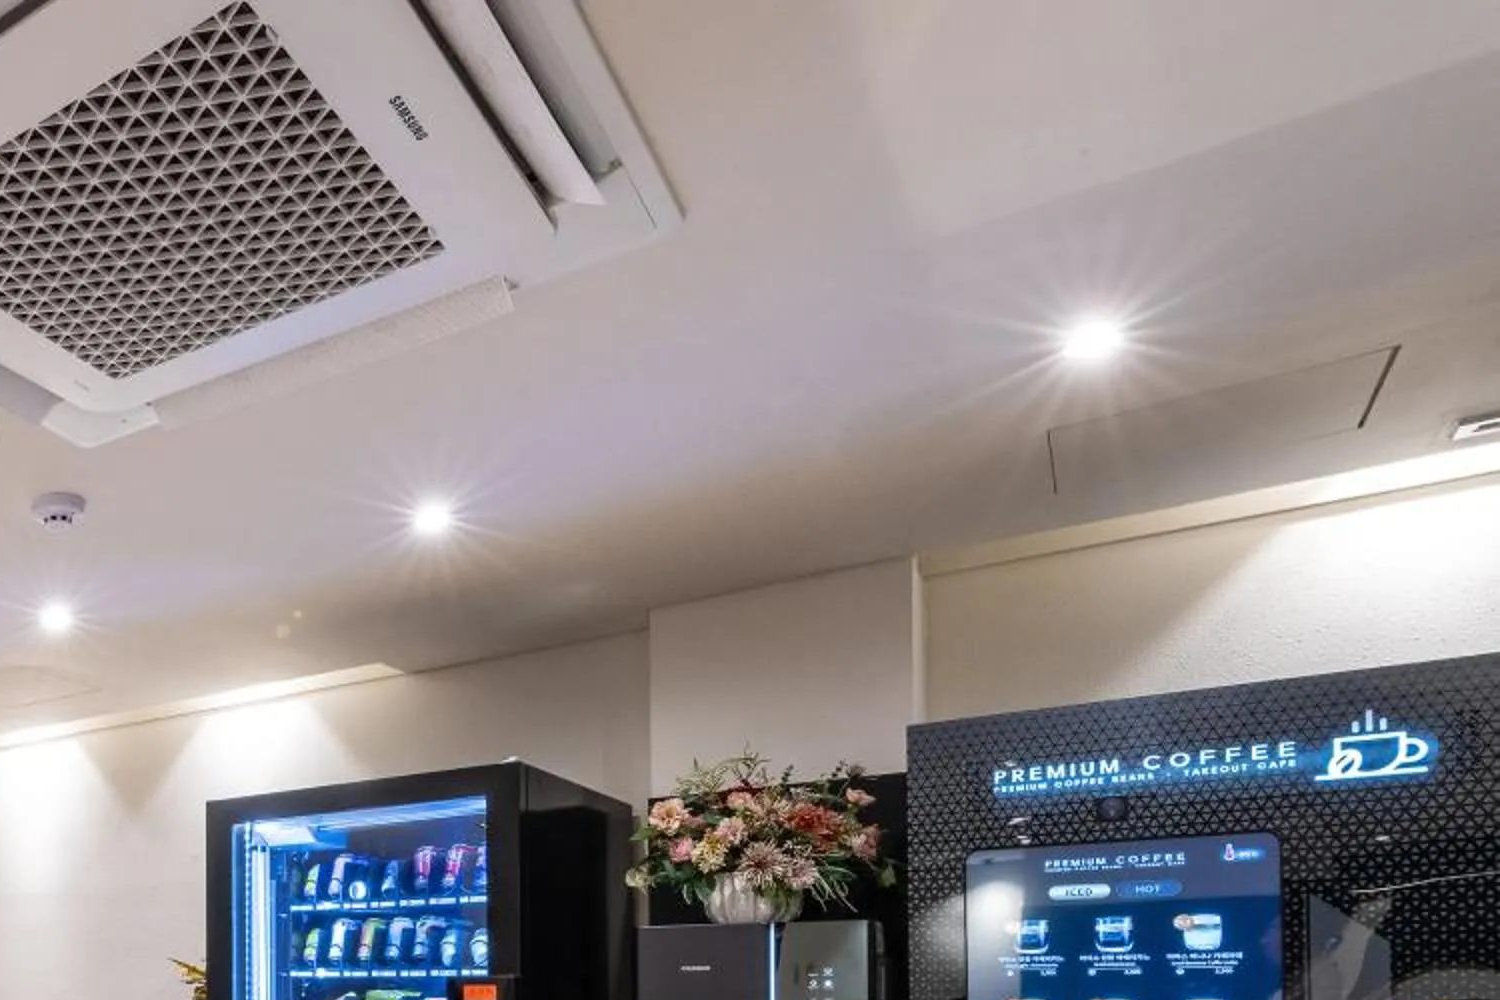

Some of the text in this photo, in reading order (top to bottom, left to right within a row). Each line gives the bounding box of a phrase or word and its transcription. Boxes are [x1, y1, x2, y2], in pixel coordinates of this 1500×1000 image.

[389, 95, 429, 141] SAMSUNG
[993, 741, 1297, 785] PREMIUM COFFEE
[1183, 763, 1249, 777] TAKEOUT
[1256, 759, 1298, 770] CAFE
[1044, 857, 1107, 868] PREMIUM
[1115, 852, 1186, 865] COFFEE
[1064, 884, 1160, 897] ICED HOT
